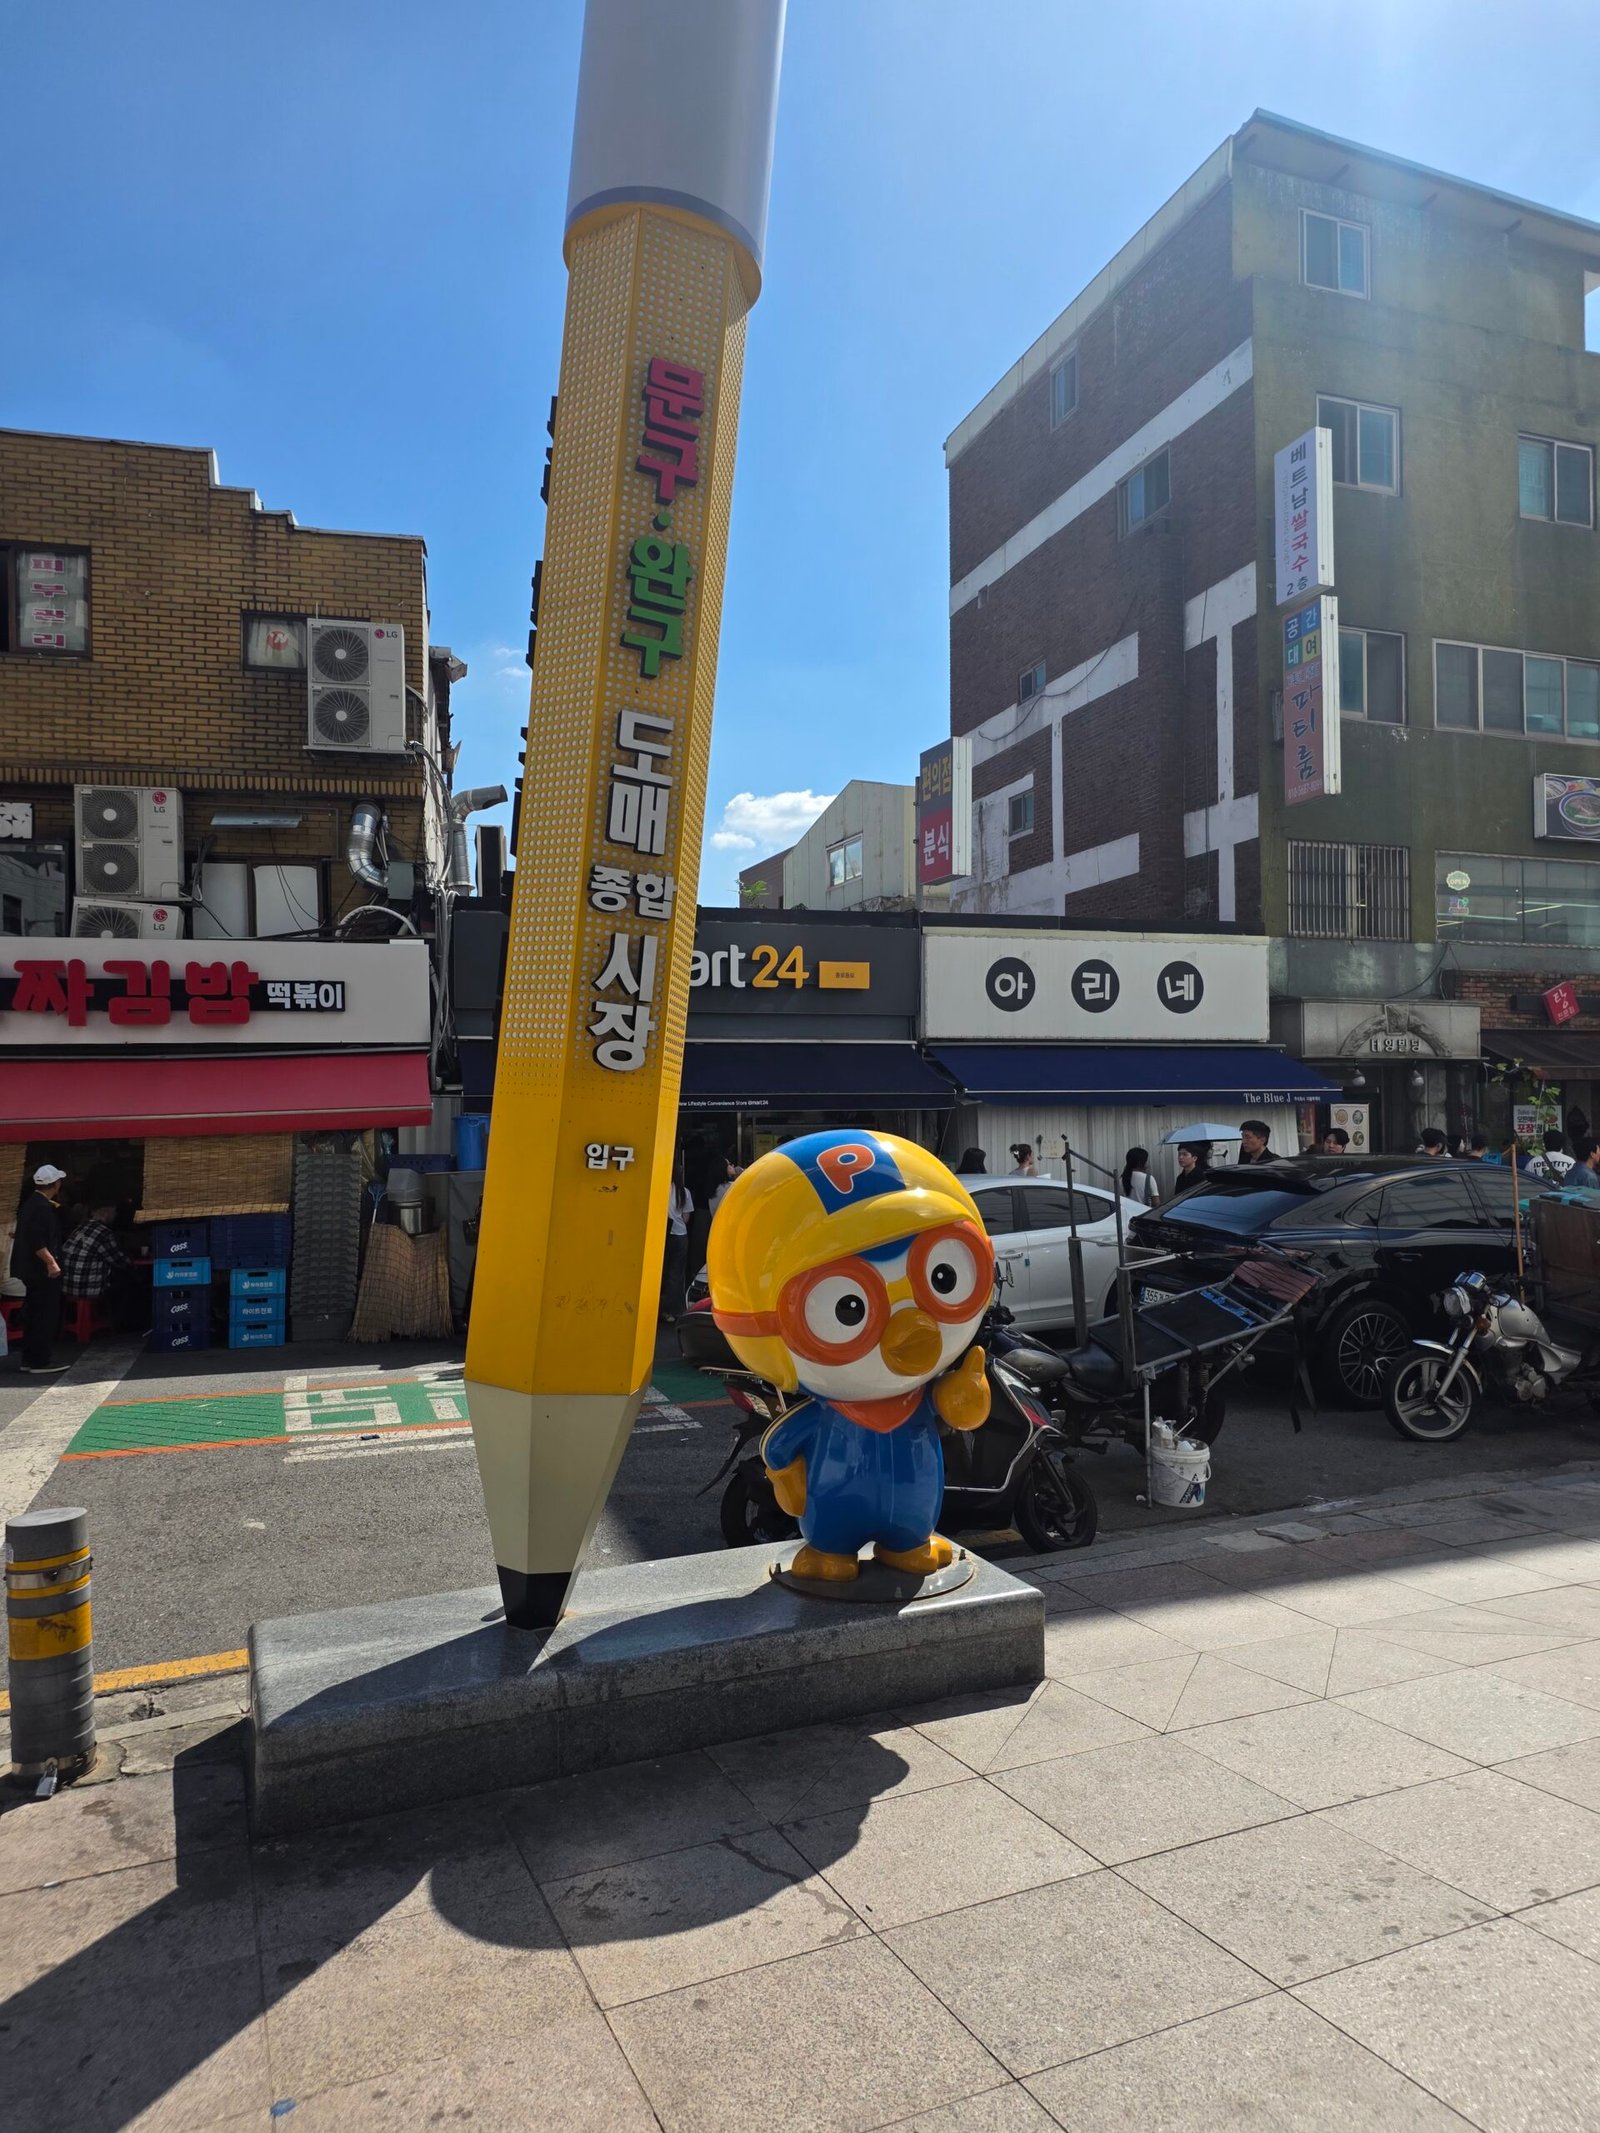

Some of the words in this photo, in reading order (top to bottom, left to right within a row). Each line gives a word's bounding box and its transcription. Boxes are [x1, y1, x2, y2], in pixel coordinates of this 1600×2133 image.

[1286, 576, 1308, 596] 2층
[386, 631, 398, 639] LG
[1291, 684, 1322, 780] 파티룸
[608, 710, 673, 856] 도매
[922, 753, 952, 802] 편의점
[923, 821, 949, 866] 분식
[591, 865, 677, 920] 종합
[690, 944, 809, 989] art24
[0, 959, 260, 1027] 짜김밥
[266, 982, 343, 1009] 떡볶이
[591, 933, 658, 1072] 시장
[1243, 1093, 1262, 1103] The
[1264, 1093, 1285, 1103] Blue
[1286, 1092, 1291, 1103] J
[586, 1144, 635, 1171] 입구
[816, 1143, 876, 1195] P
[1533, 1160, 1572, 1169] IDETITY
